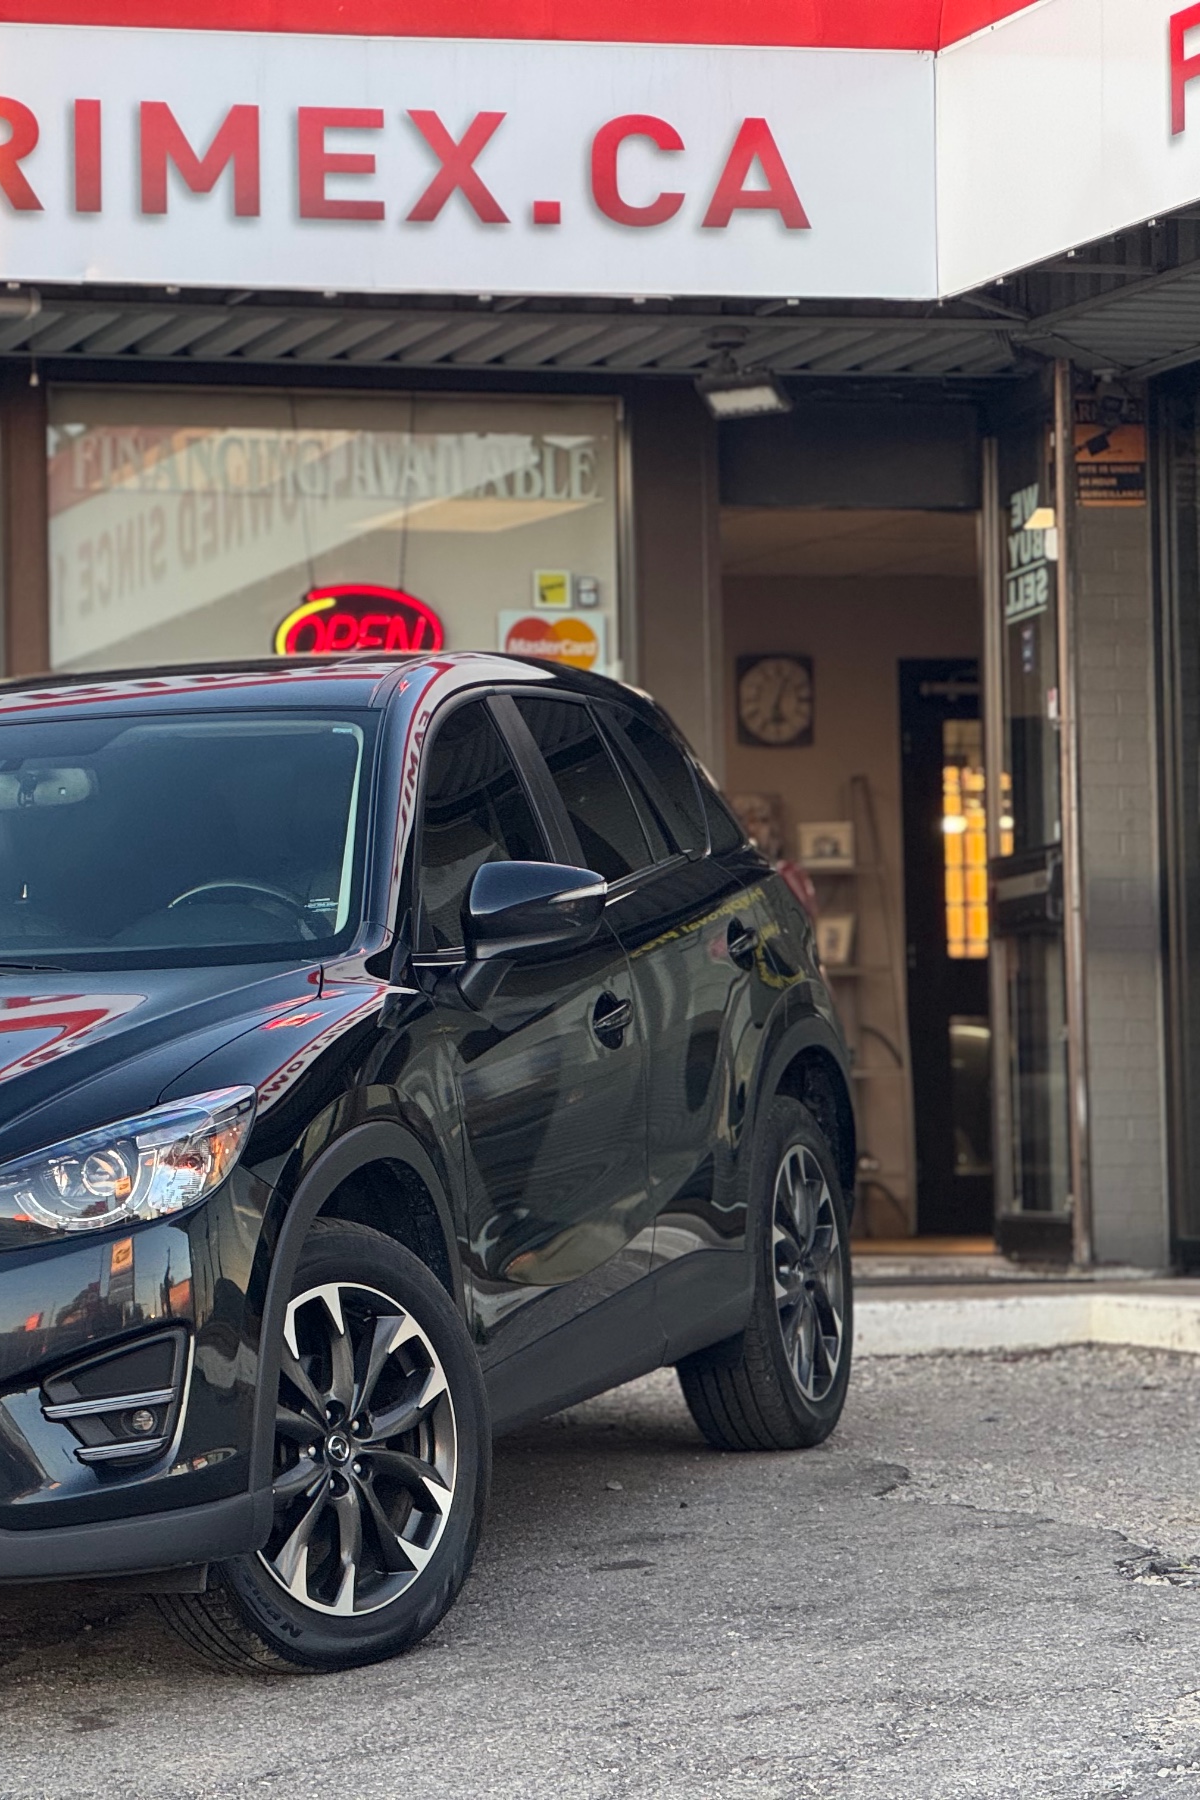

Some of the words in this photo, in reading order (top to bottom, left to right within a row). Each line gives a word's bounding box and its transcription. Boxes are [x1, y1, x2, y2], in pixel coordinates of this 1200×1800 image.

[352, 434, 601, 501] AVAILABLE
[286, 613, 427, 653] OPEN
[508, 638, 597, 657] MasterCard
